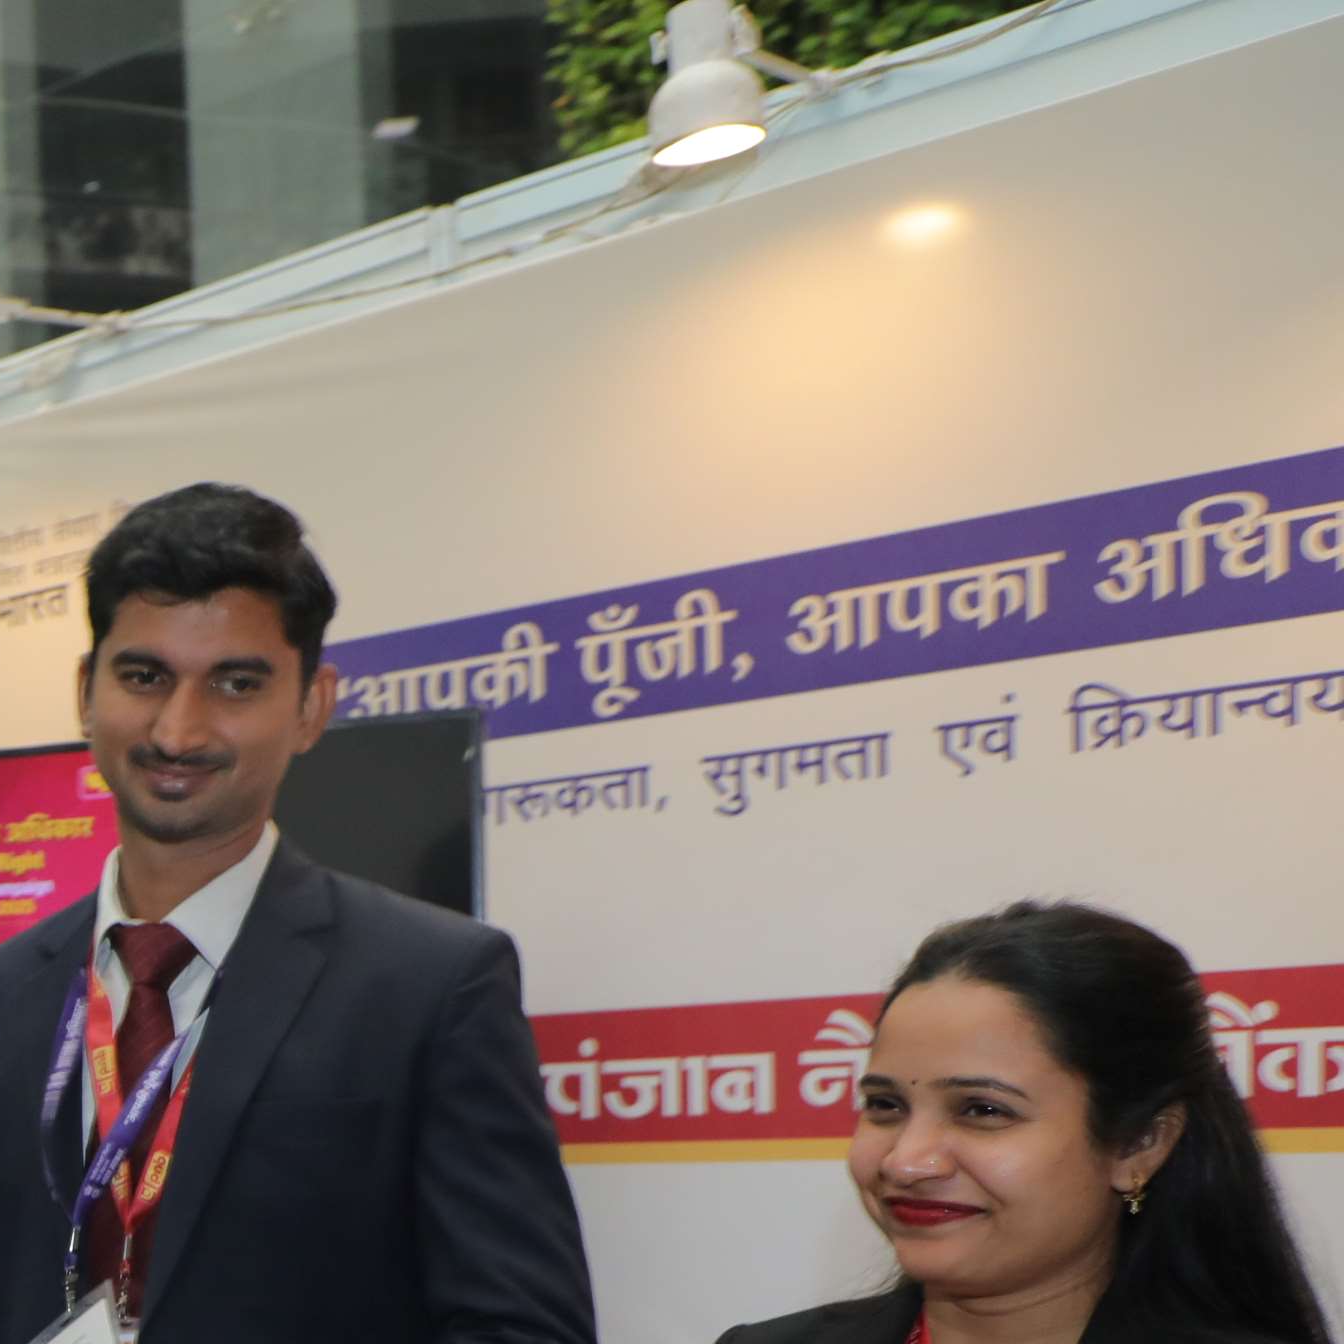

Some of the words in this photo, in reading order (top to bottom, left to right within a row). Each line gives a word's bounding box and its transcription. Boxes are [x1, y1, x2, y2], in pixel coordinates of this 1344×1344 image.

[574, 588, 755, 718] पूँजी,
[784, 550, 1067, 655] आपका
[700, 731, 892, 816] सुगमता
[935, 693, 1020, 778] एवं
[1064, 667, 1344, 756] क्रियान्वय
[539, 1038, 776, 1119] पंजाब
[149, 1155, 168, 1185] pnb
